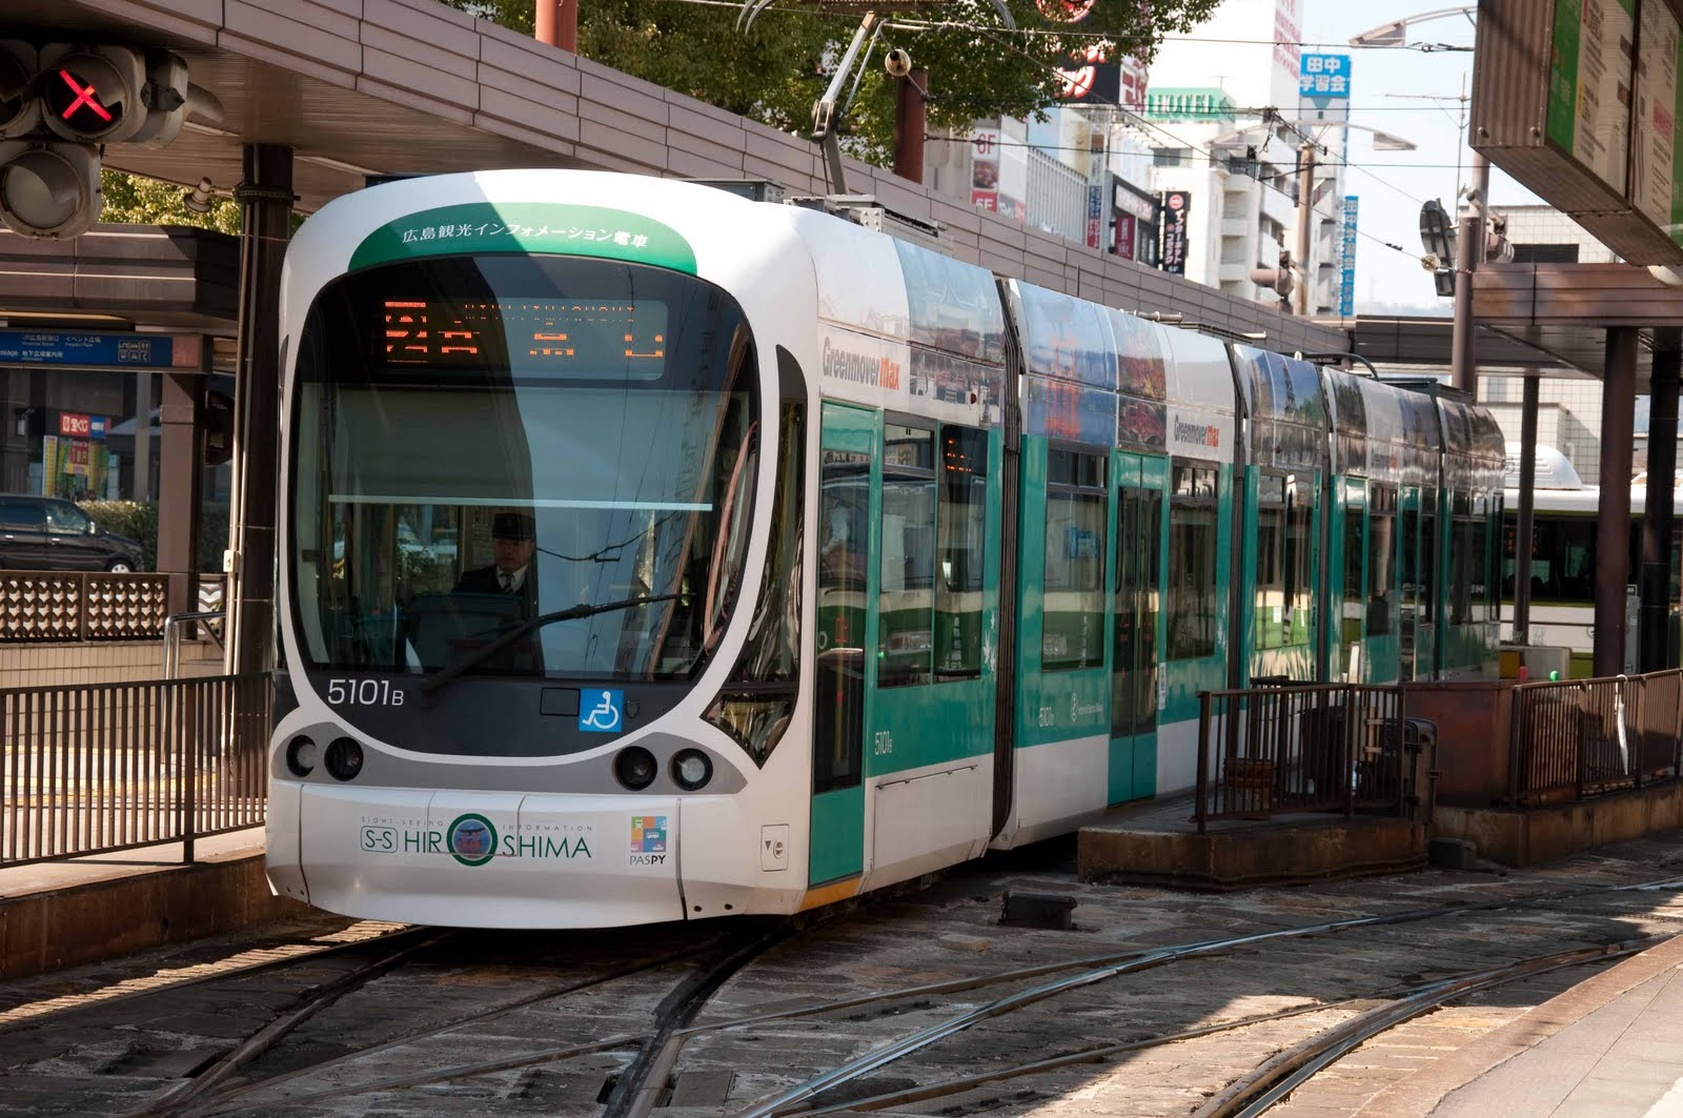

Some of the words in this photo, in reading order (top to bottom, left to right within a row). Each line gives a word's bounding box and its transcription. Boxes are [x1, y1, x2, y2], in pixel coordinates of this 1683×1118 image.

[1306, 56, 1341, 74] 田中
[1299, 73, 1346, 92] 学習会
[1152, 94, 1218, 117] HOTEL
[977, 133, 996, 155] 6F
[402, 223, 649, 248] 広島観光インフォメーション電車
[328, 679, 404, 706] 5101B
[629, 854, 666, 866] PASPY
